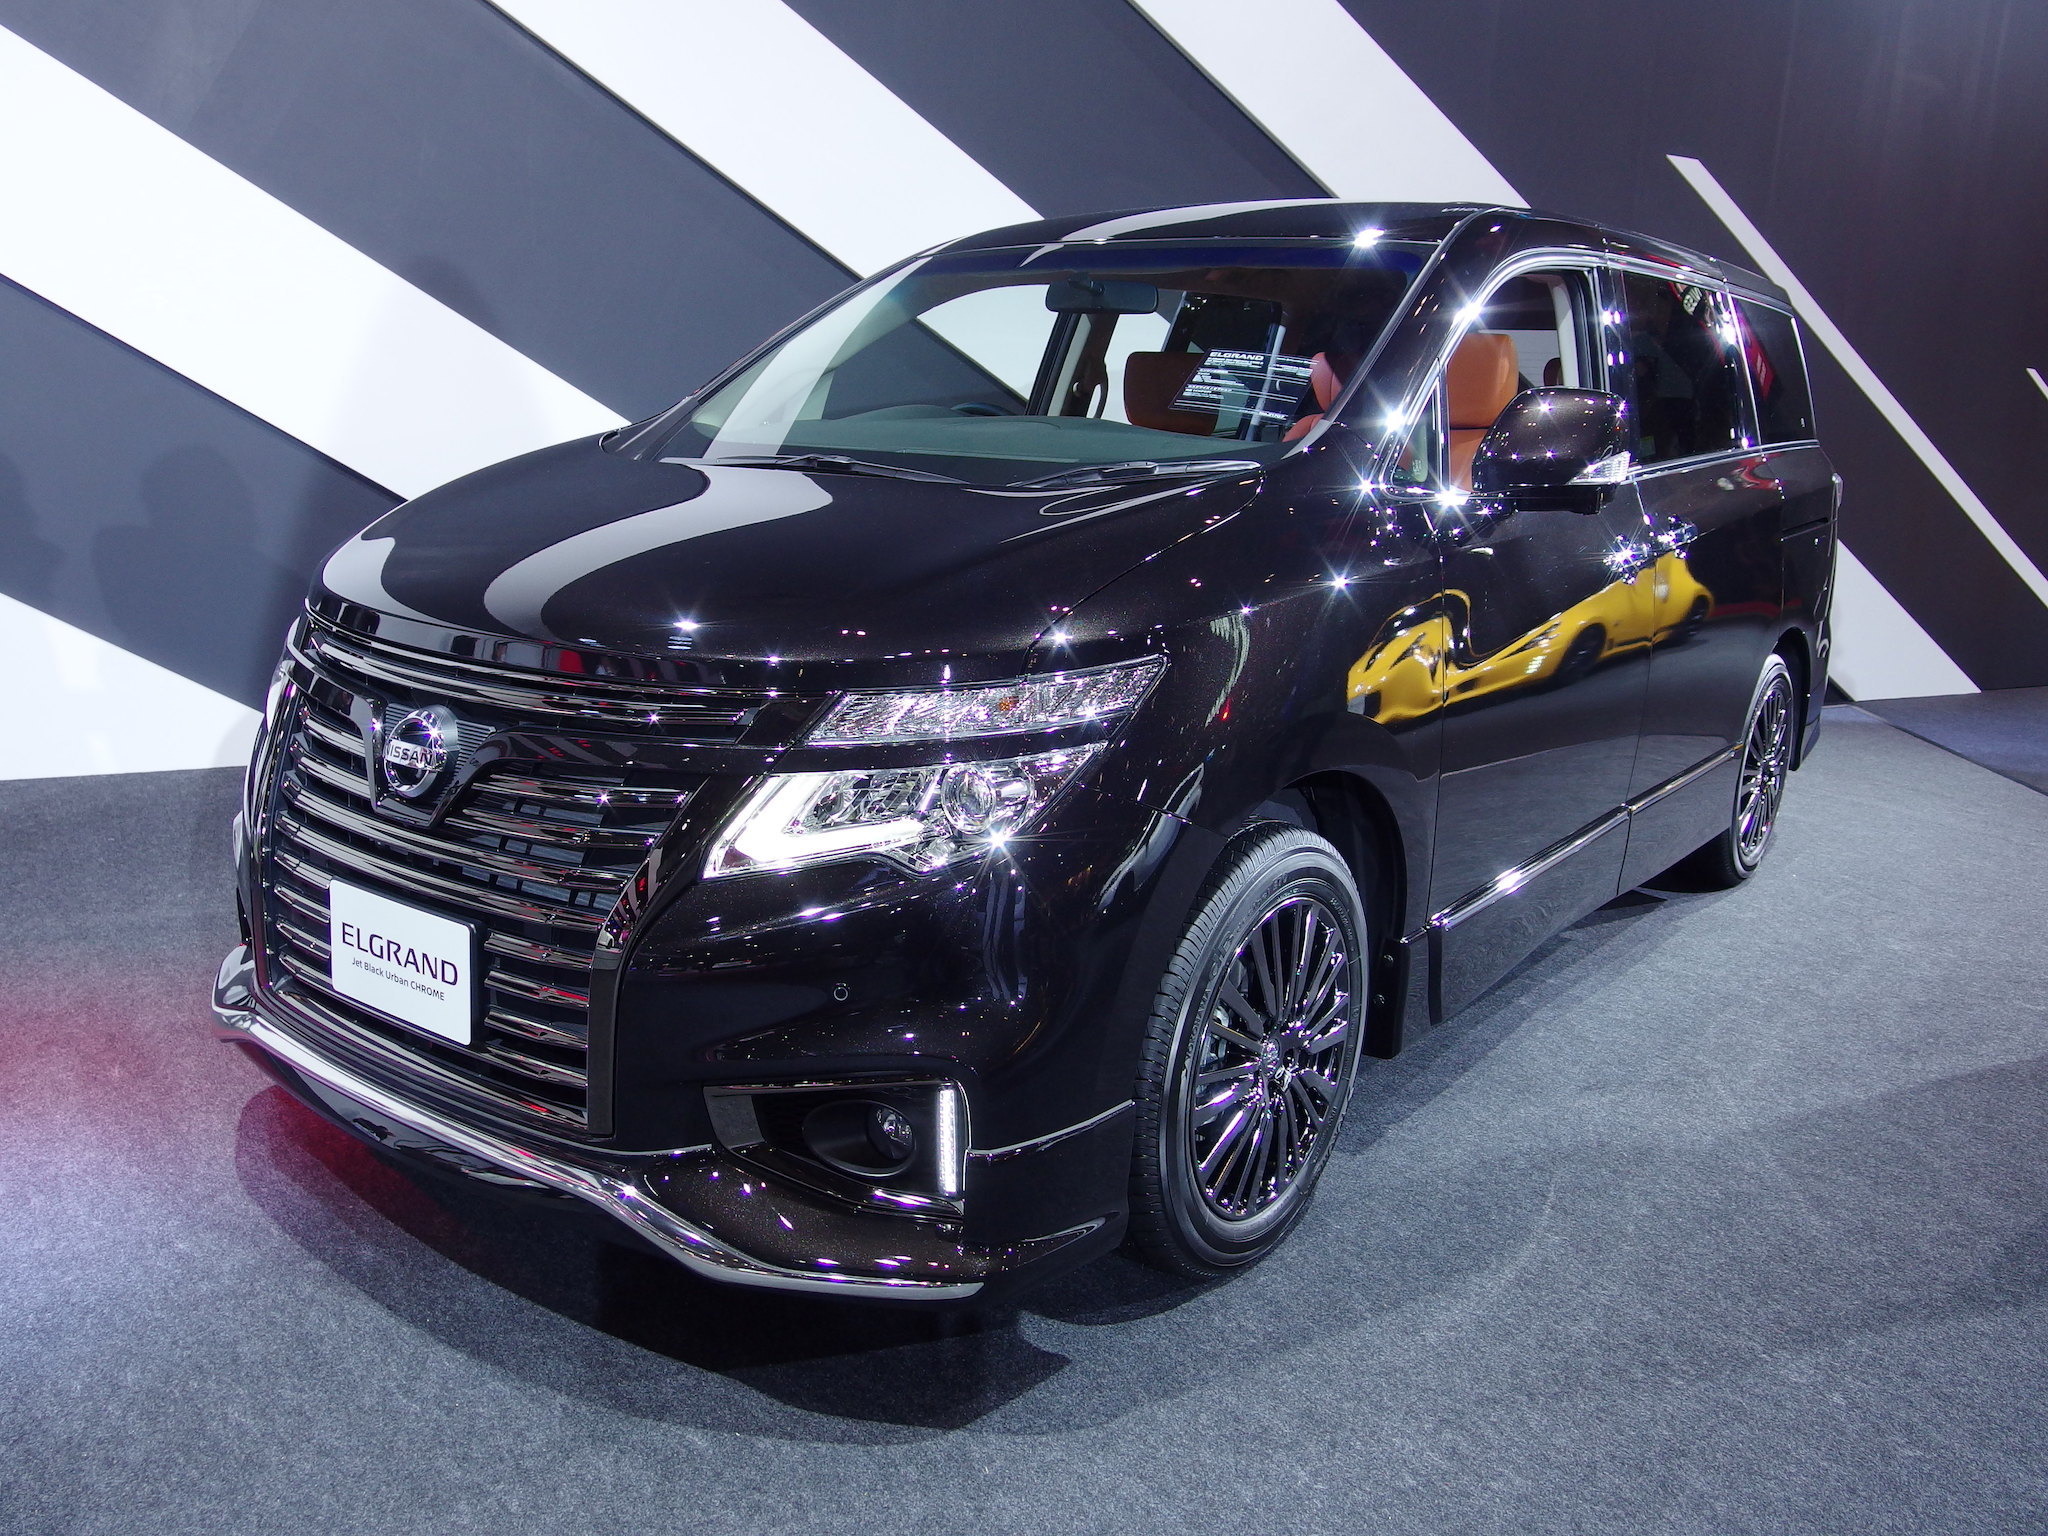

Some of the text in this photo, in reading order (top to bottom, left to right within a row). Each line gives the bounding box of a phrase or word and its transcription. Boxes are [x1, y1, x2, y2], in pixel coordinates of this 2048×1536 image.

[1210, 351, 1264, 361] ELGRAND
[385, 744, 433, 766] NISSAN
[342, 922, 458, 986] ELGRAND
[352, 957, 445, 1001] Jet Black Urban CHROME
